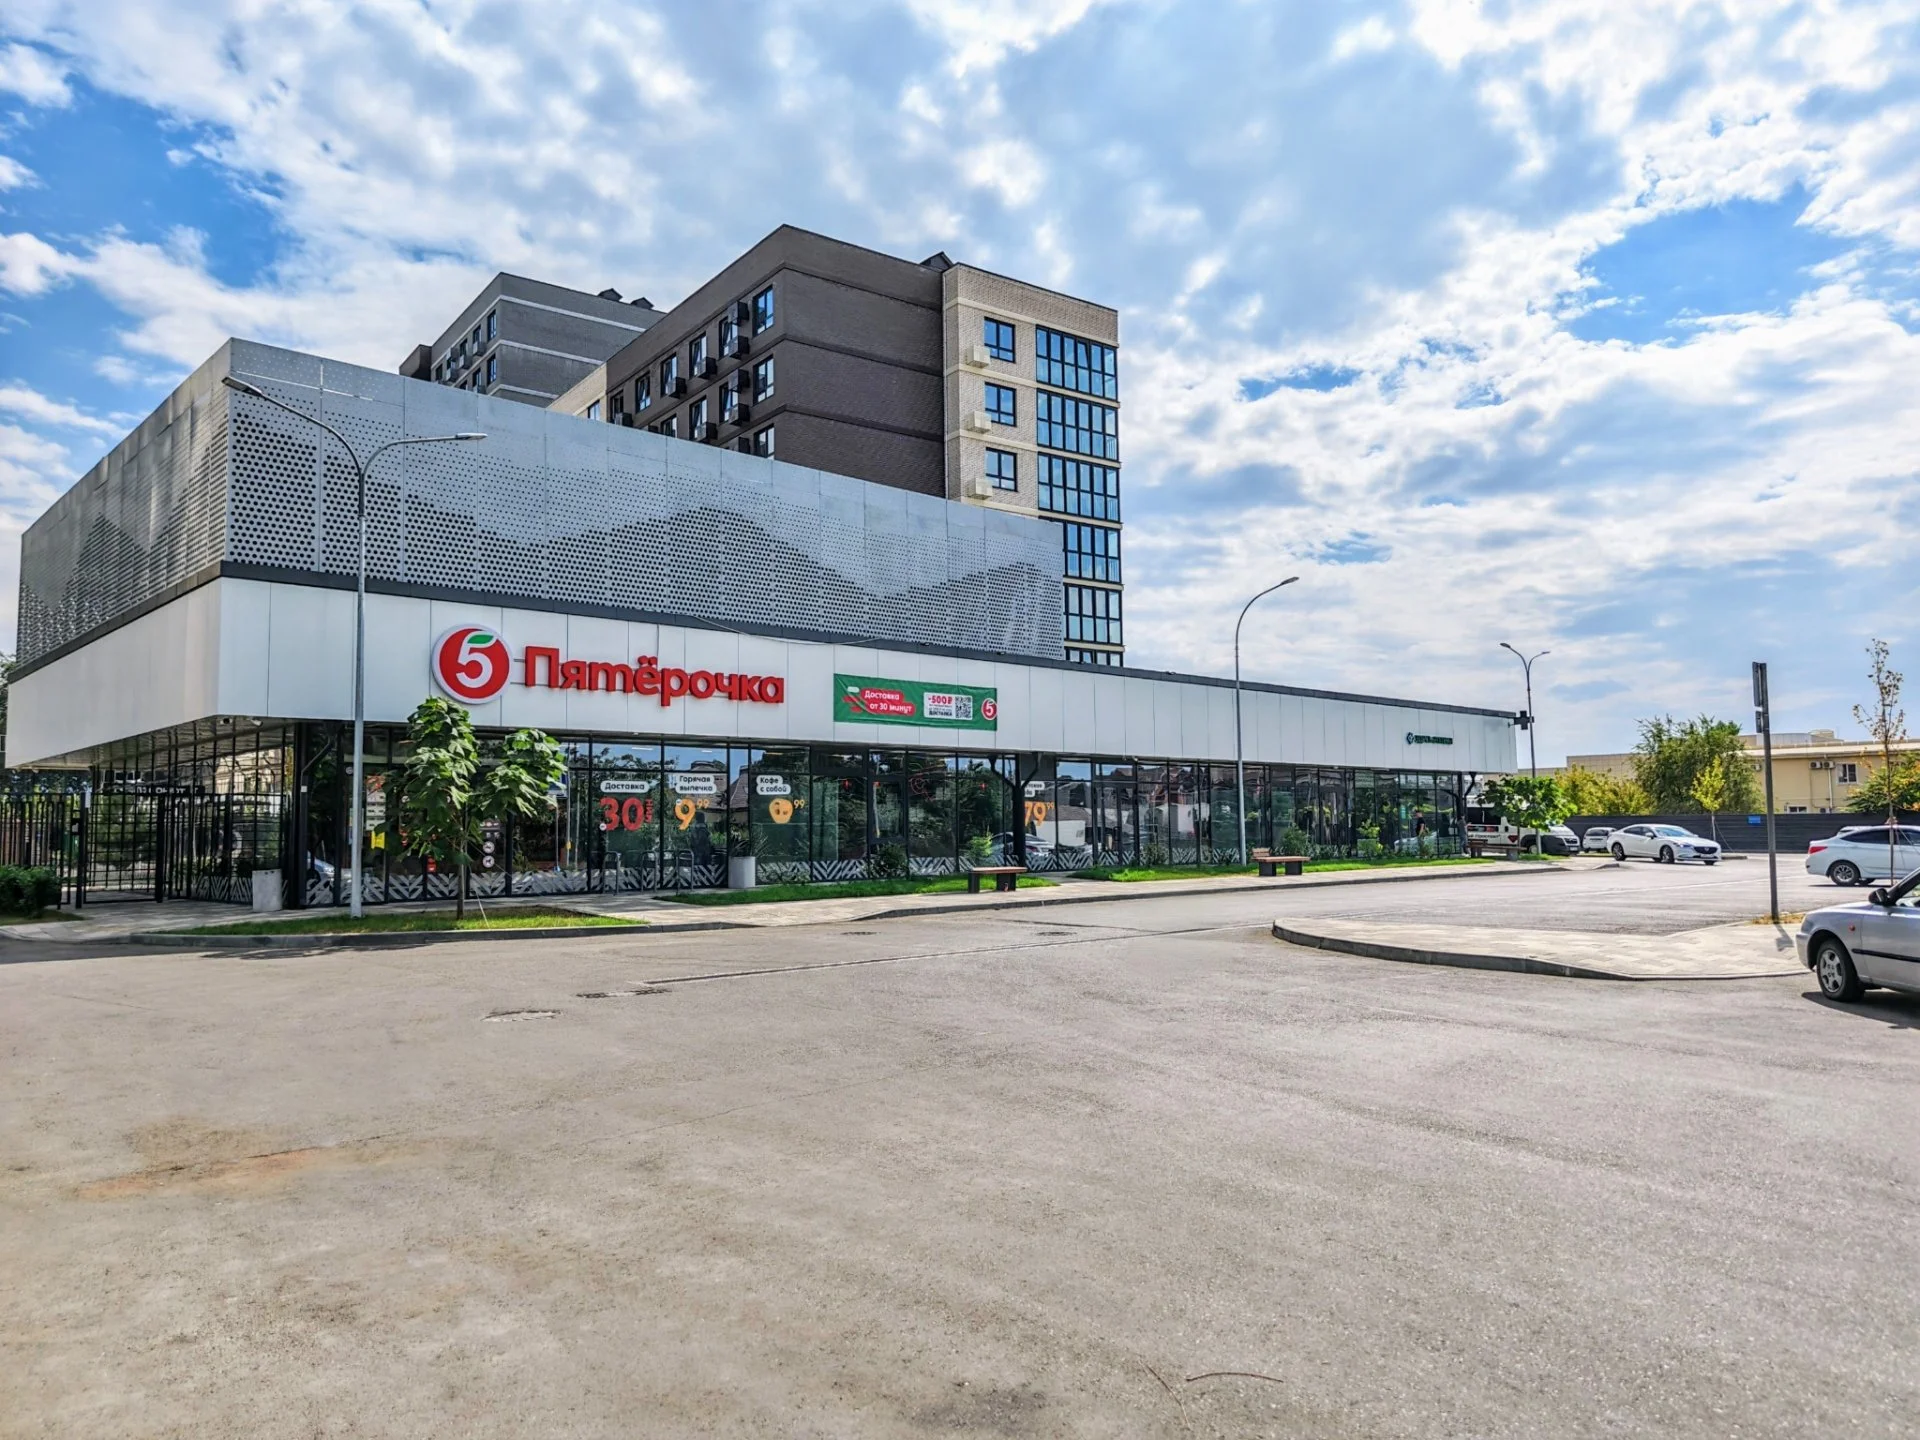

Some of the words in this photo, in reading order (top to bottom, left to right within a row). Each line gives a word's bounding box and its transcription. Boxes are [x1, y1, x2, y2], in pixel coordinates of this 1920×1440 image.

[456, 633, 494, 688] 5
[524, 646, 785, 706] Пятёрочка
[864, 690, 900, 701] Доставка
[879, 703, 888, 711] 30
[889, 704, 912, 714] минут
[986, 702, 994, 716] 5
[680, 775, 711, 784] Горячая
[760, 777, 779, 785] Кофе
[604, 782, 645, 791] Доставка
[679, 784, 713, 792] выпечка
[766, 785, 787, 793] собой
[600, 797, 645, 831] 30
[675, 798, 696, 831] 9
